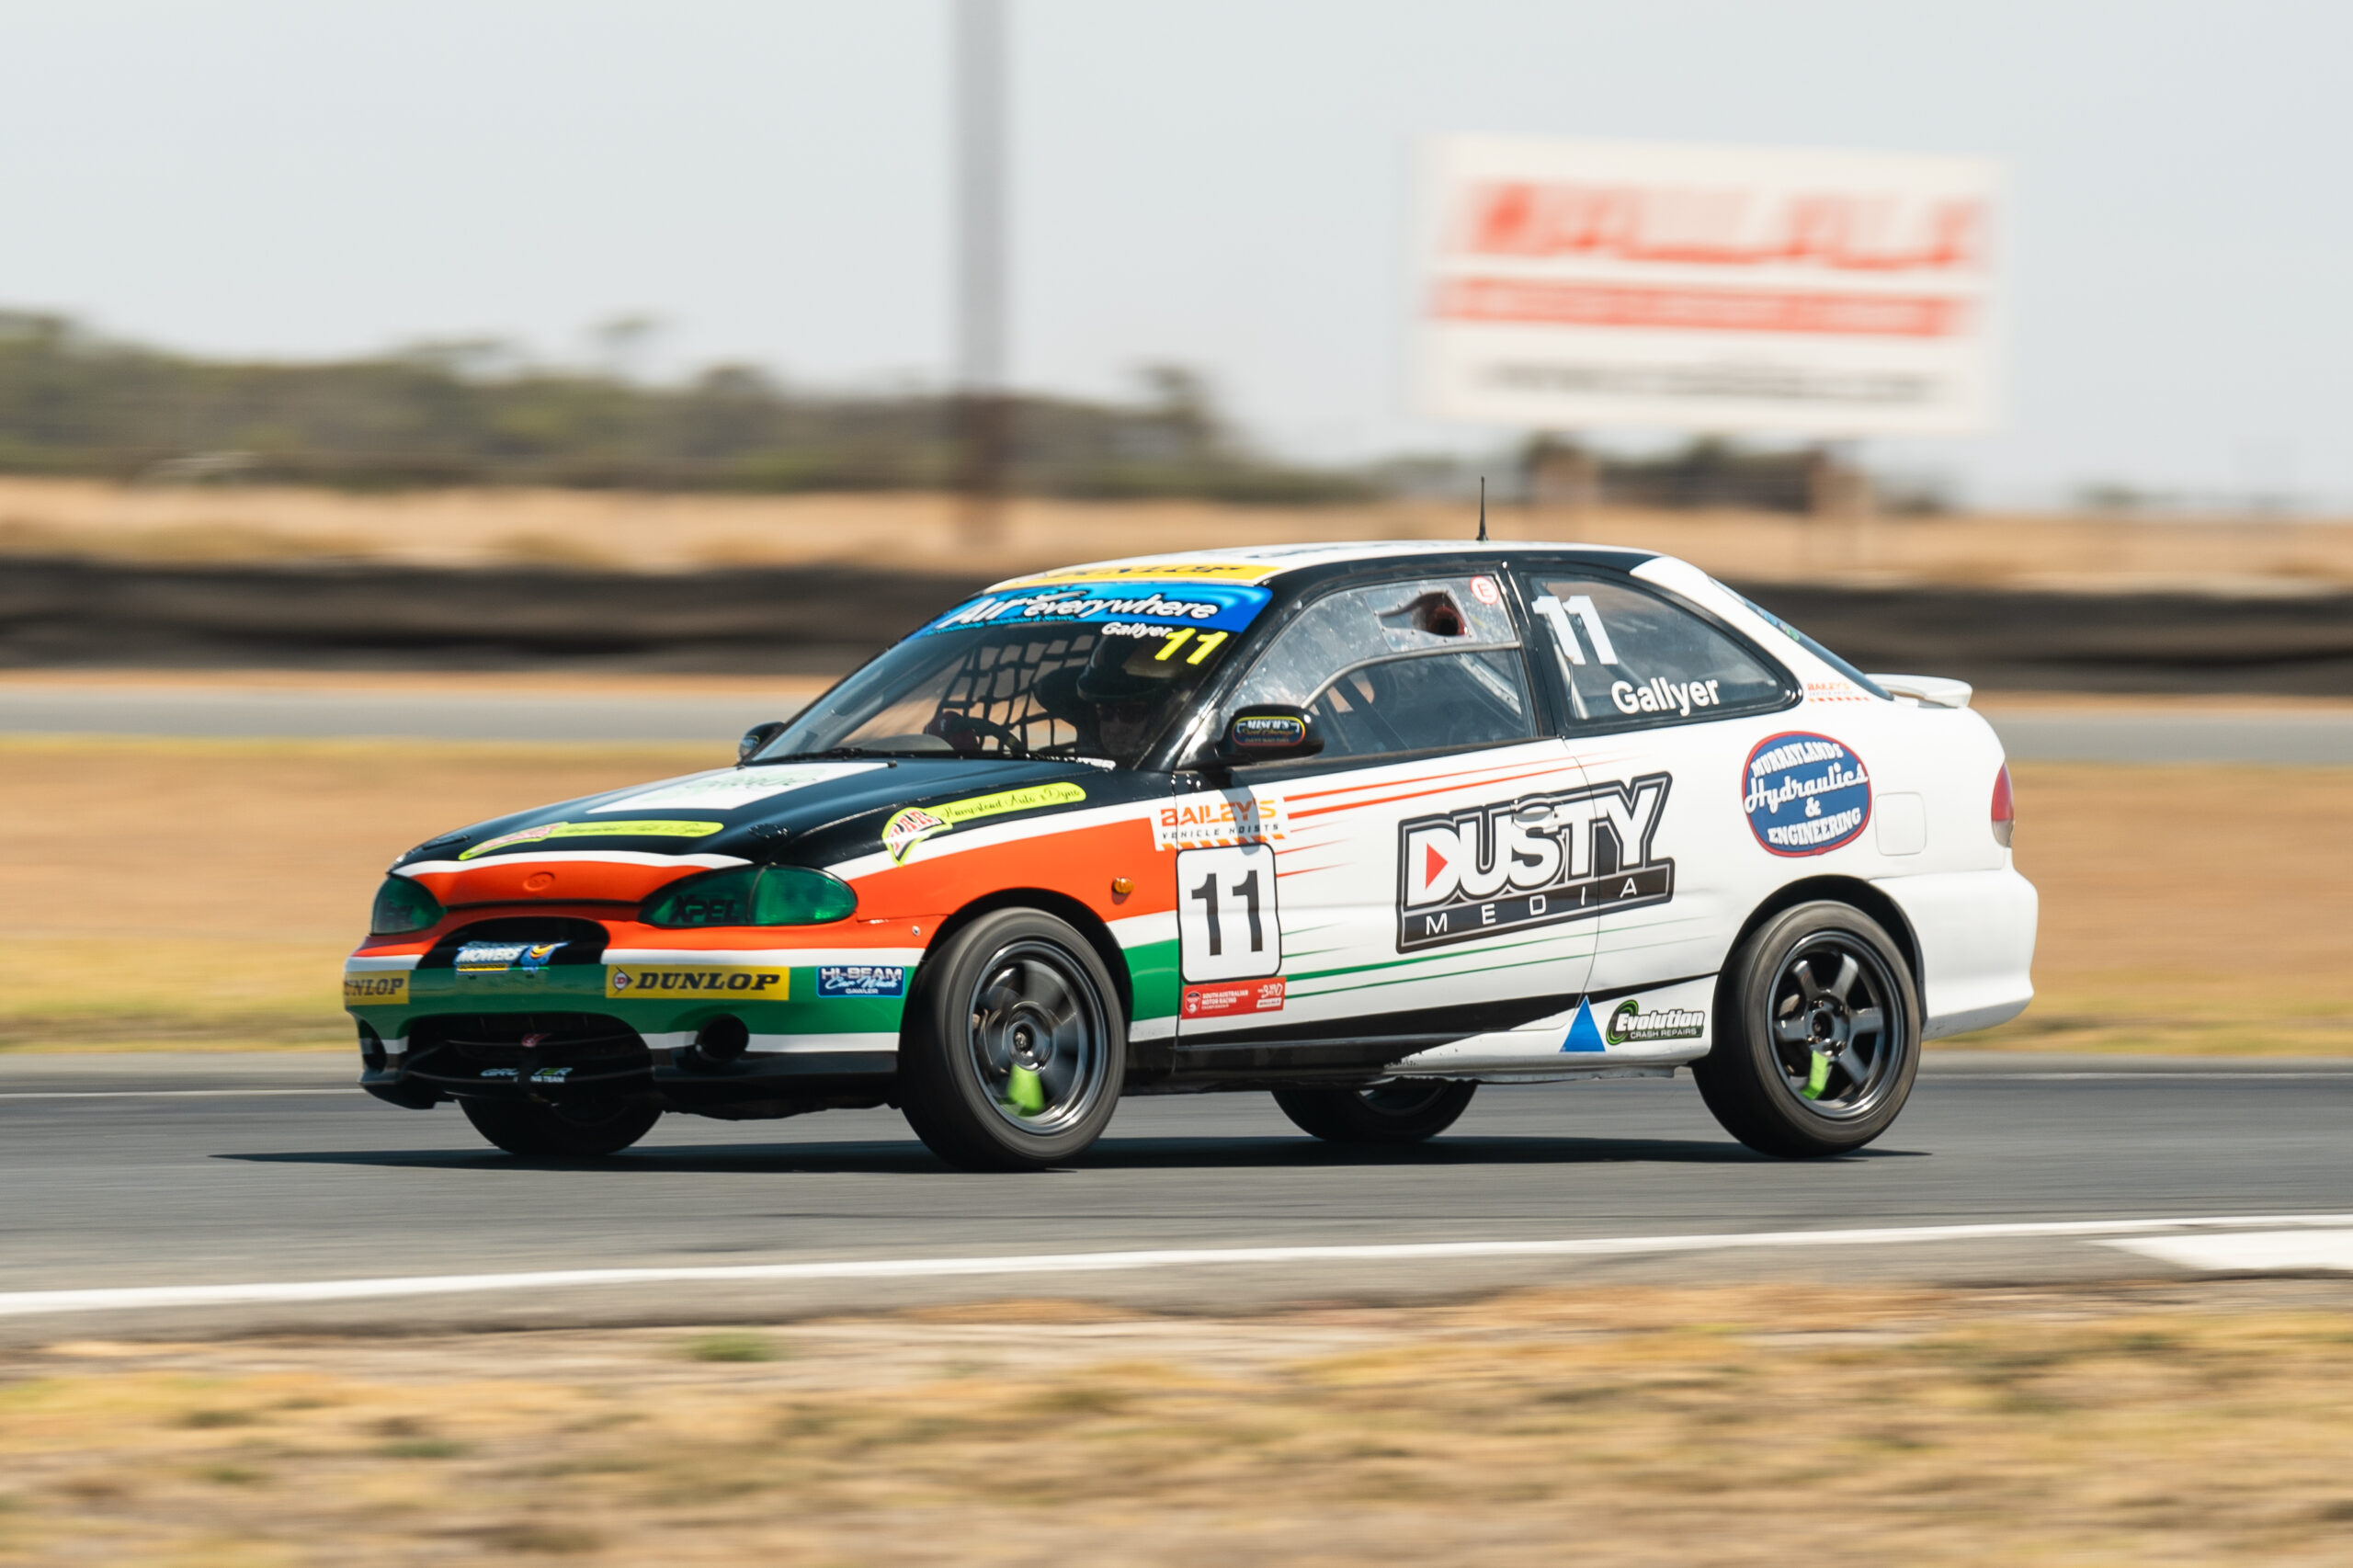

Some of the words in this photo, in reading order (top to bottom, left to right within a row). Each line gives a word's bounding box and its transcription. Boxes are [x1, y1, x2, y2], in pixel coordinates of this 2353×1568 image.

[1023, 594, 1219, 619] everywhere
[1101, 621, 1173, 639] Gallyer
[1530, 595, 1619, 665] 11
[1154, 627, 1229, 665] 11
[1611, 676, 1719, 717] Gallyer
[1750, 741, 1844, 778] MURRAYLANDS
[1745, 762, 1869, 813] Hydraulics
[1160, 800, 1277, 827] BAILEY'S
[1804, 797, 1822, 818] &
[1163, 828, 1221, 840] VEHICLE
[1229, 823, 1279, 835] HOISTS
[1768, 808, 1862, 846] ENGINEERING
[1405, 785, 1659, 908] DUSTY
[669, 895, 739, 923] XPEL
[1191, 869, 1263, 957] 11
[1426, 877, 1638, 936] MEDIA
[635, 971, 781, 991] DUNLOP
[821, 967, 903, 980] HI-BEAM
[1615, 1010, 1704, 1032] Evolution
[1630, 1028, 1659, 1040] CRASH
[1661, 1028, 1698, 1038] REPAIRS
